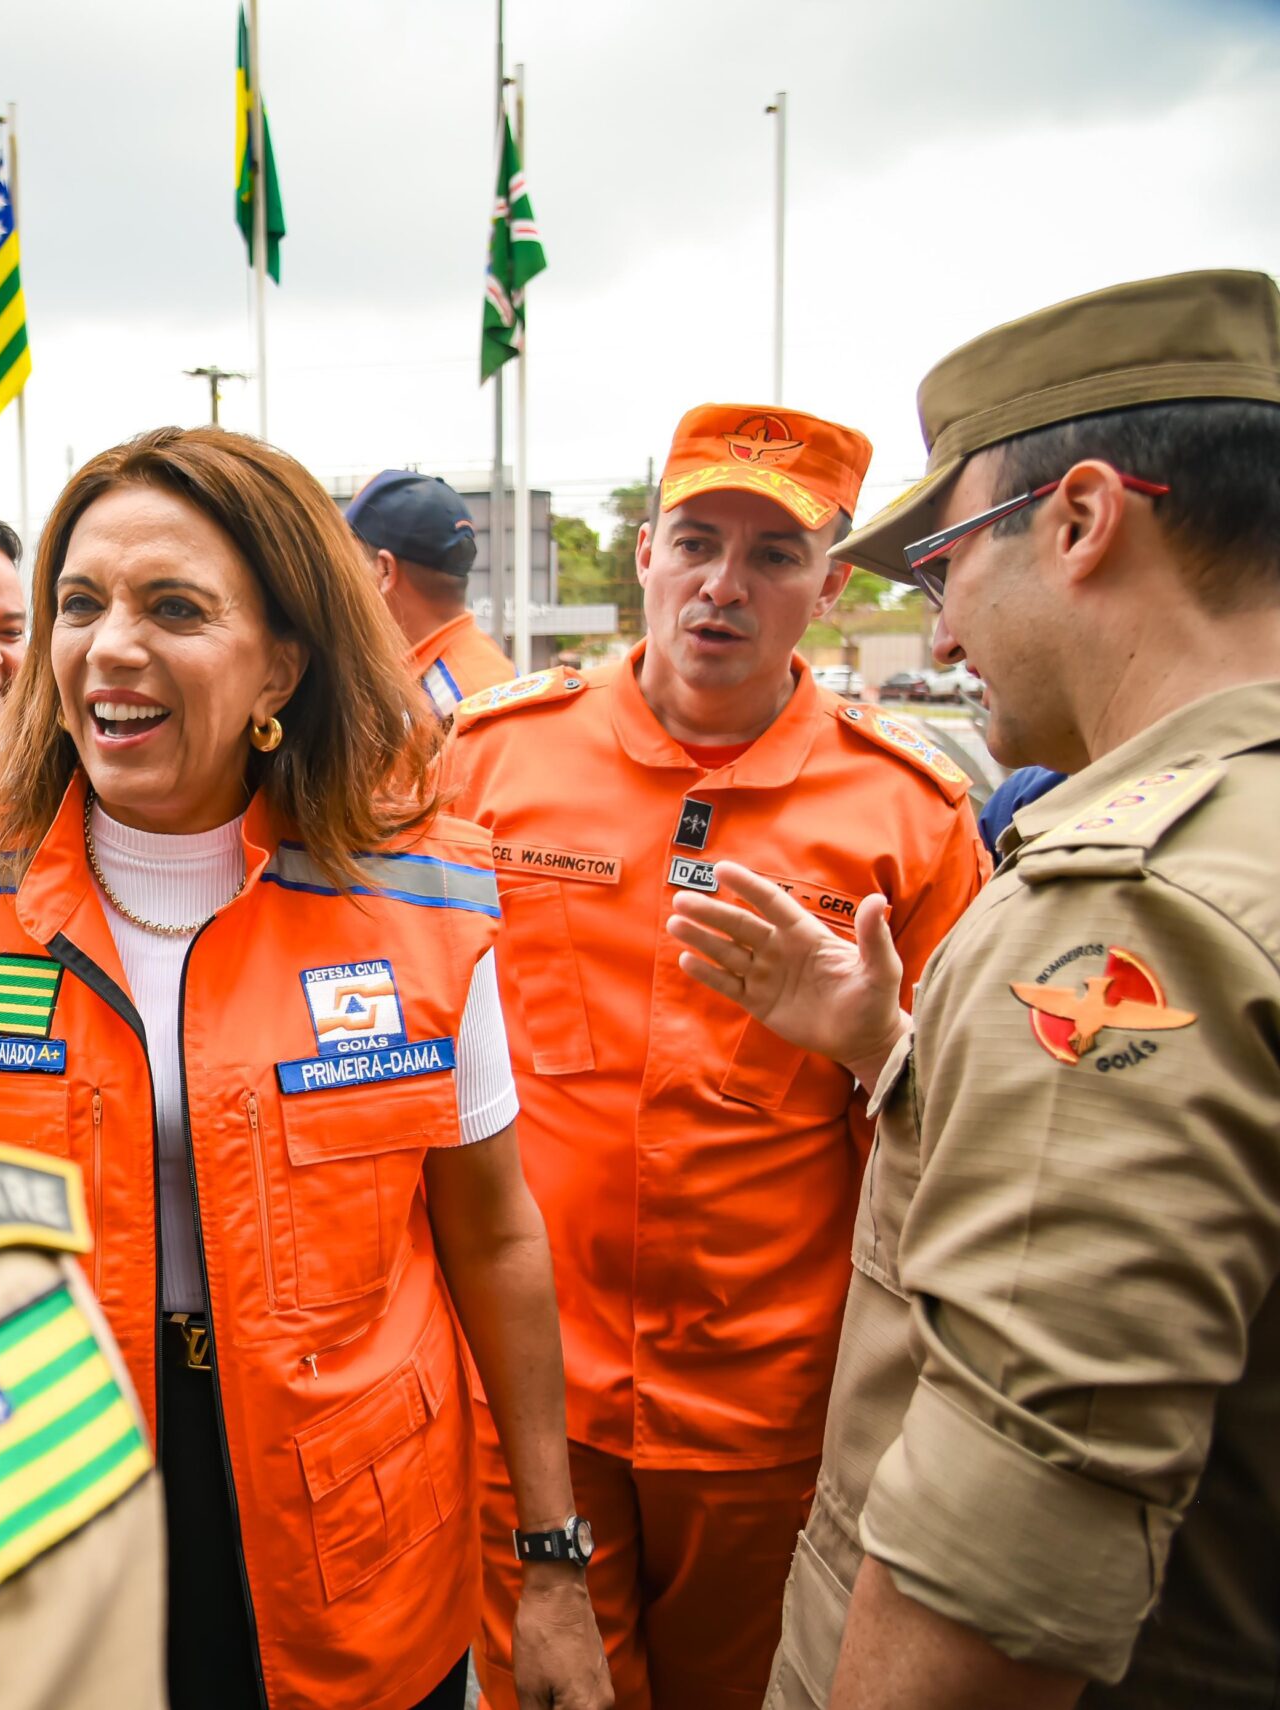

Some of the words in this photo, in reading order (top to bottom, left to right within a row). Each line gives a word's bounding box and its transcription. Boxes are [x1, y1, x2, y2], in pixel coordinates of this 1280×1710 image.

[521, 850, 616, 875] WASHINGTON
[819, 894, 857, 919] GER
[305, 966, 353, 983] DEFESA
[355, 961, 388, 976] CIVIL
[337, 1036, 389, 1053] GOIÁS
[1095, 1040, 1158, 1073] GOIÁS
[301, 1045, 443, 1091] PRIMEIRA-DAMA
